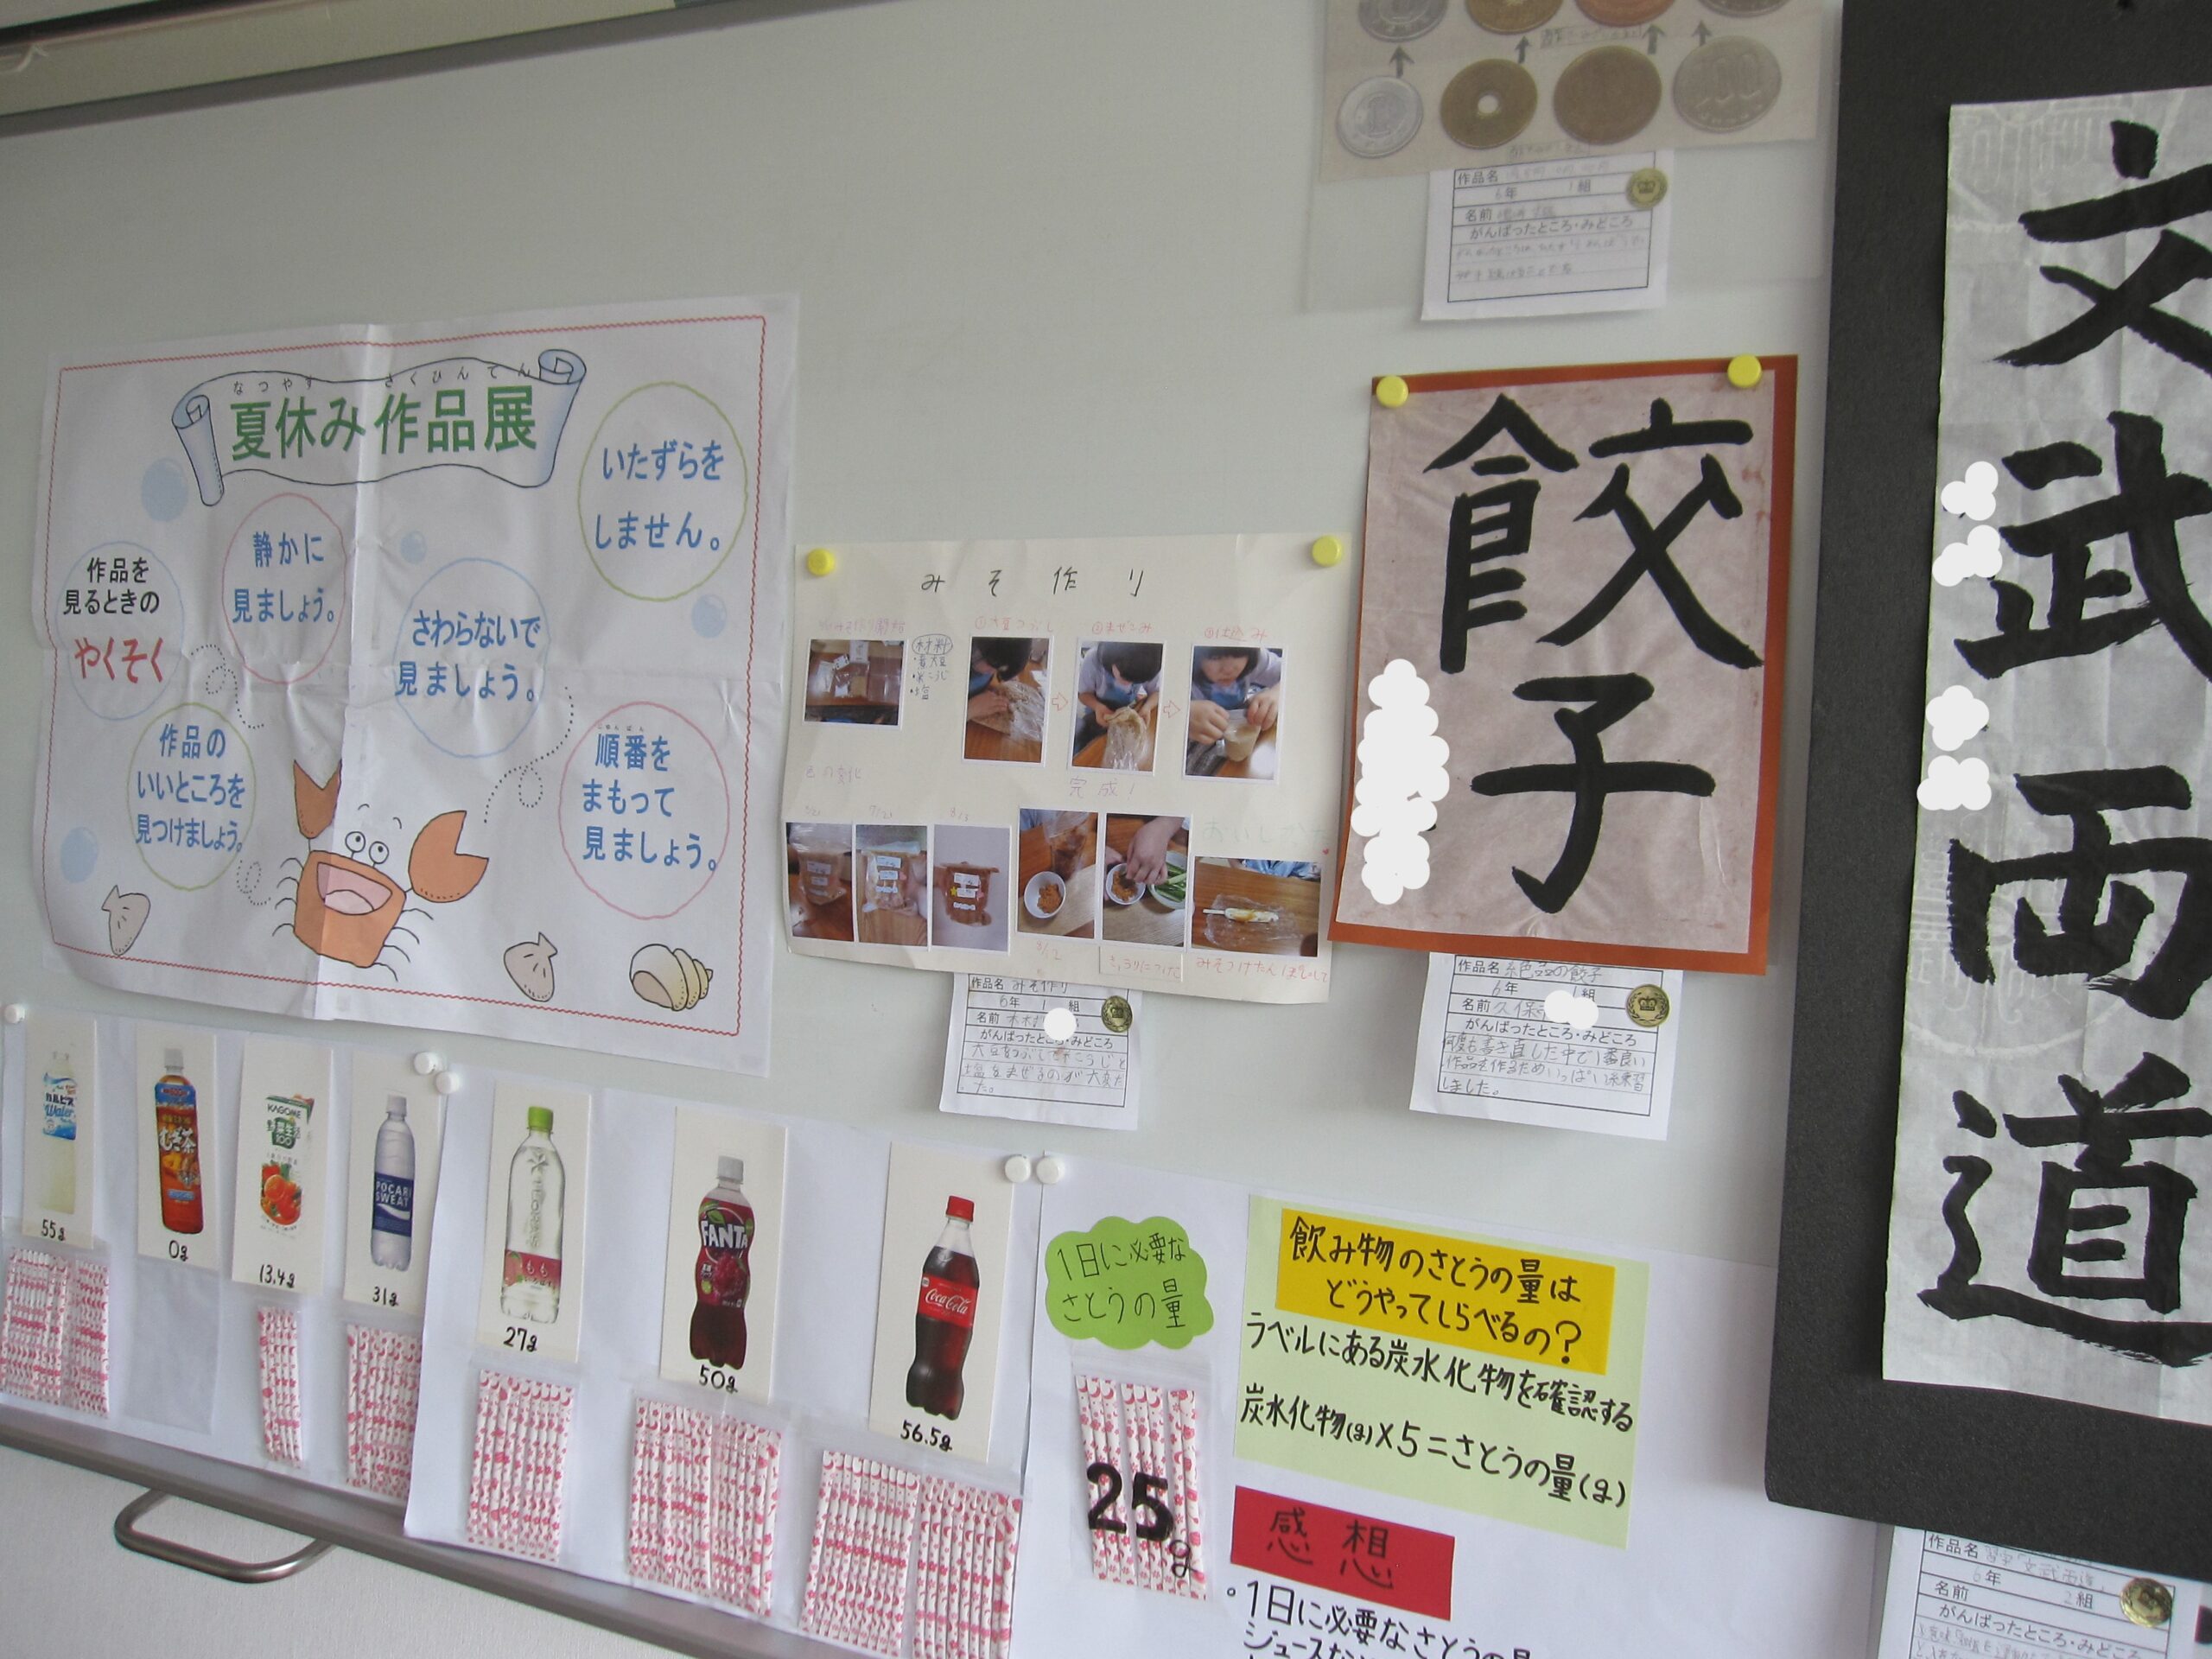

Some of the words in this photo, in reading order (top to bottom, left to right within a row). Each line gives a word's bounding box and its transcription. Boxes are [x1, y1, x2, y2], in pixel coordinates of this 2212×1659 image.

[1457, 169, 1498, 186] 作品名
[1465, 207, 1492, 222] 名前
[229, 385, 537, 461] 夏休み作品展
[602, 439, 724, 481] いたずらを
[252, 531, 325, 568] 静かに
[595, 511, 721, 551] しません。
[86, 556, 149, 584] 作品を
[63, 588, 160, 614] 見るときの
[232, 588, 335, 624] 見ましょう。
[412, 609, 541, 648] さわらないで
[74, 637, 164, 683] やくそく
[1423, 393, 1764, 914] 餃子
[395, 660, 535, 702] 見ましょう。
[159, 723, 226, 759] 作品の
[595, 734, 671, 772] 順番を
[137, 770, 246, 809] いいところを
[582, 779, 675, 817] まもって
[135, 814, 244, 854] 見つけましょう。
[582, 825, 716, 872] 見ましょう。
[971, 976, 1004, 991] 作品名
[1458, 959, 1500, 976] 作品名
[977, 1011, 1000, 1025] 名前
[1462, 997, 1491, 1013] 名前
[1465, 1017, 1637, 1046] がんばったところ・みどころ
[375, 1180, 412, 1198] POCARI
[375, 1192, 410, 1208] SWEAT
[41, 1219, 66, 1242] 55g
[1057, 1232, 1186, 1281] 1日に必要な
[1290, 1215, 1581, 1305] 飲み物のさとうの量は
[1062, 1278, 1186, 1329] さとうの量
[1327, 1277, 1582, 1364] どうやってしらべるの？
[1246, 1311, 1633, 1433] ラベルにある炭水化物を確認する
[1266, 1507, 1395, 1590] 感想
[1928, 1533, 1979, 1559] 作品名
[1935, 1579, 1969, 1602] 名前
